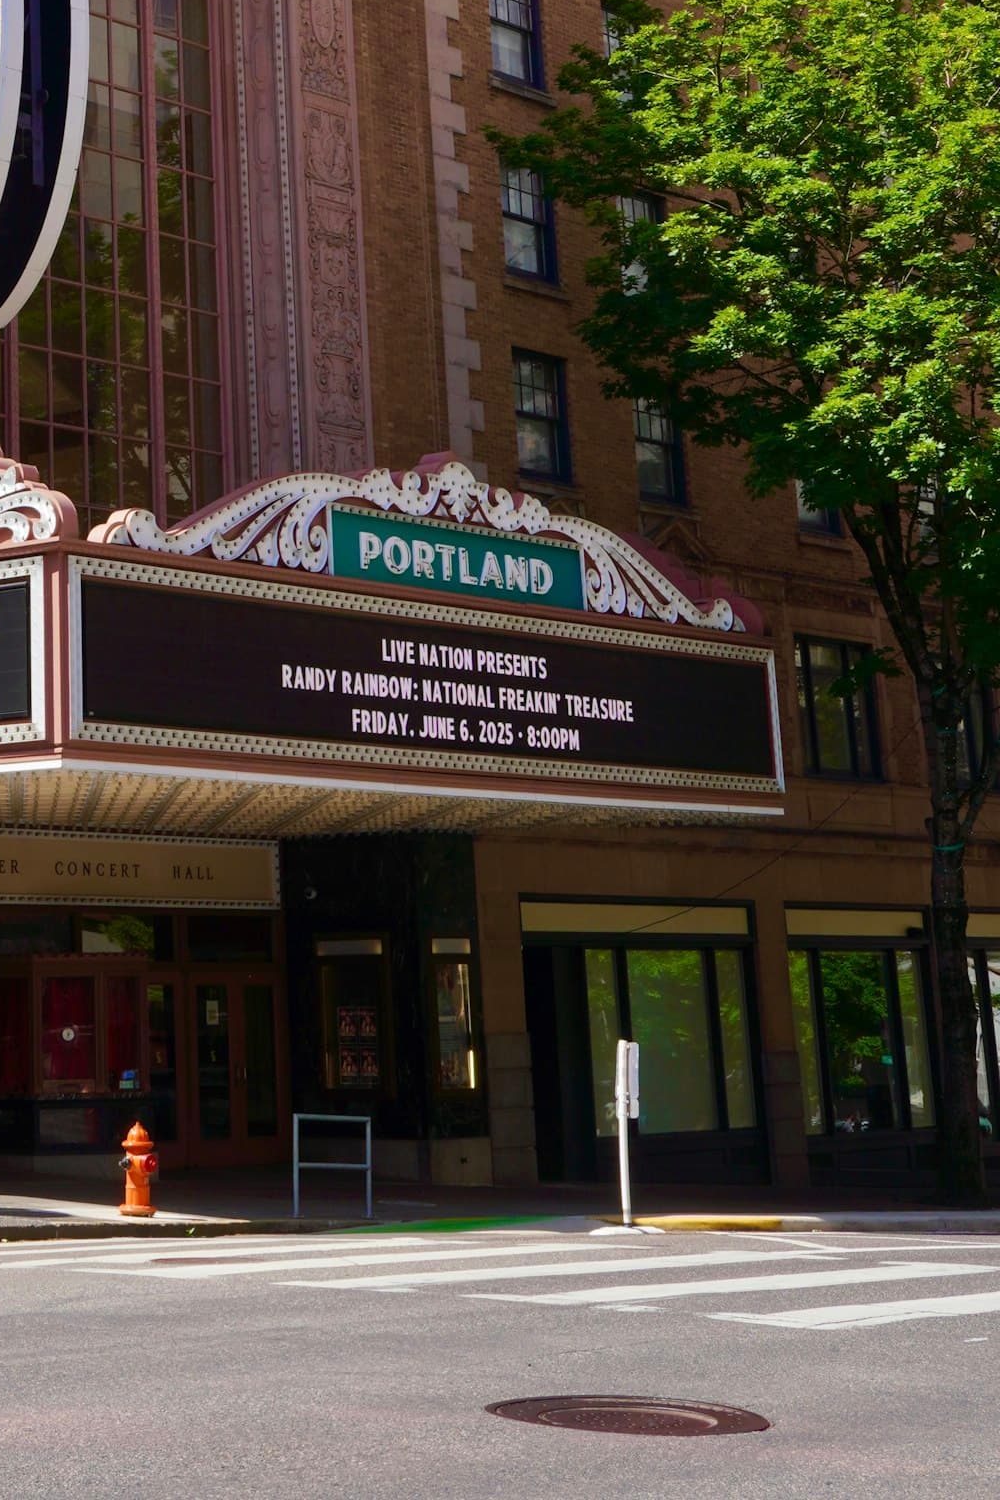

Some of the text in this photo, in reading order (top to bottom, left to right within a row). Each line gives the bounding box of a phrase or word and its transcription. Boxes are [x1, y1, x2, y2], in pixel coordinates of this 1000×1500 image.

[359, 531, 553, 595] PORTLAND
[381, 638, 548, 679] LIVE NATION PRESENTS
[282, 664, 634, 722] RANDY RAINBOW: NATIONAL FREAKIN' TREASURE
[352, 708, 414, 738] FRIDAY,
[419, 715, 456, 741] JUNE
[460, 719, 474, 743] 6,
[479, 720, 513, 745] 2025
[527, 725, 580, 751] 8:00PM
[55, 861, 142, 879] CONCERT
[172, 865, 214, 881] HALL
